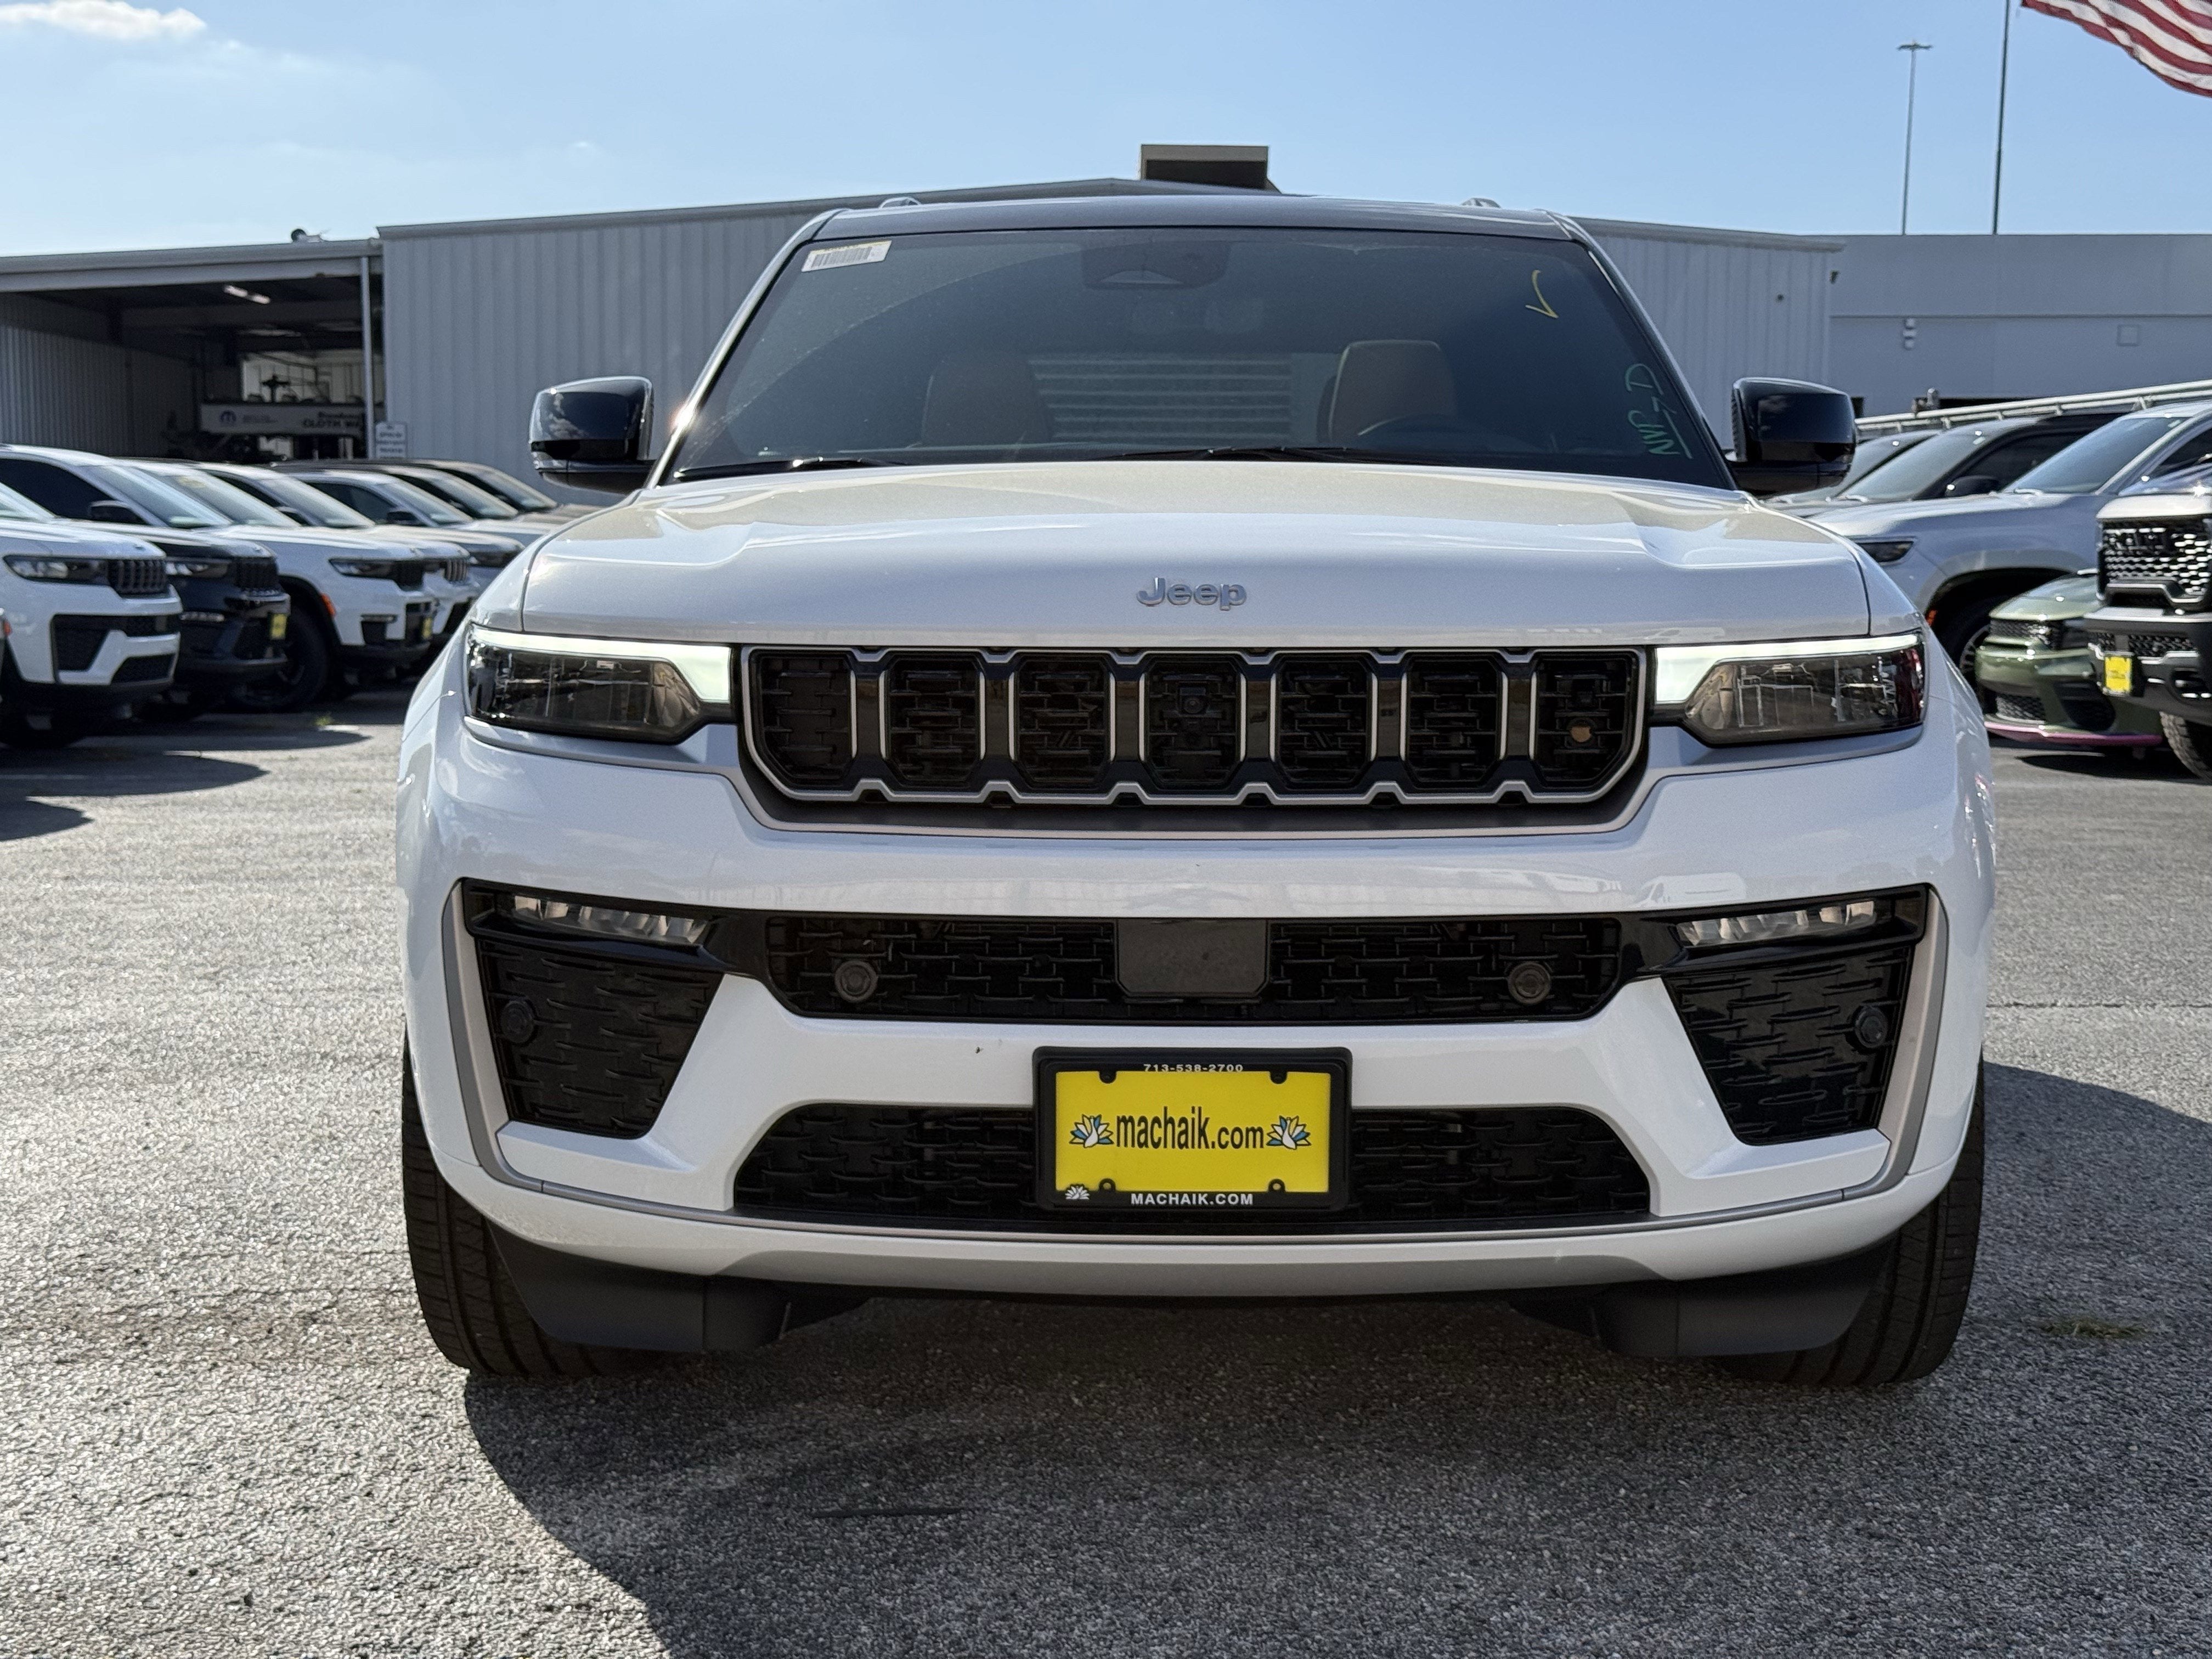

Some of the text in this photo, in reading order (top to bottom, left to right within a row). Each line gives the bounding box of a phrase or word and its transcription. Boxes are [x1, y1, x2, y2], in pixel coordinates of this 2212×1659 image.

[1136, 577, 1247, 611] Jeep
[1143, 1063, 1244, 1073] 713-538-2700
[1116, 1105, 1265, 1149] machaik.com
[1130, 1193, 1254, 1206] MACHAIK.COM
